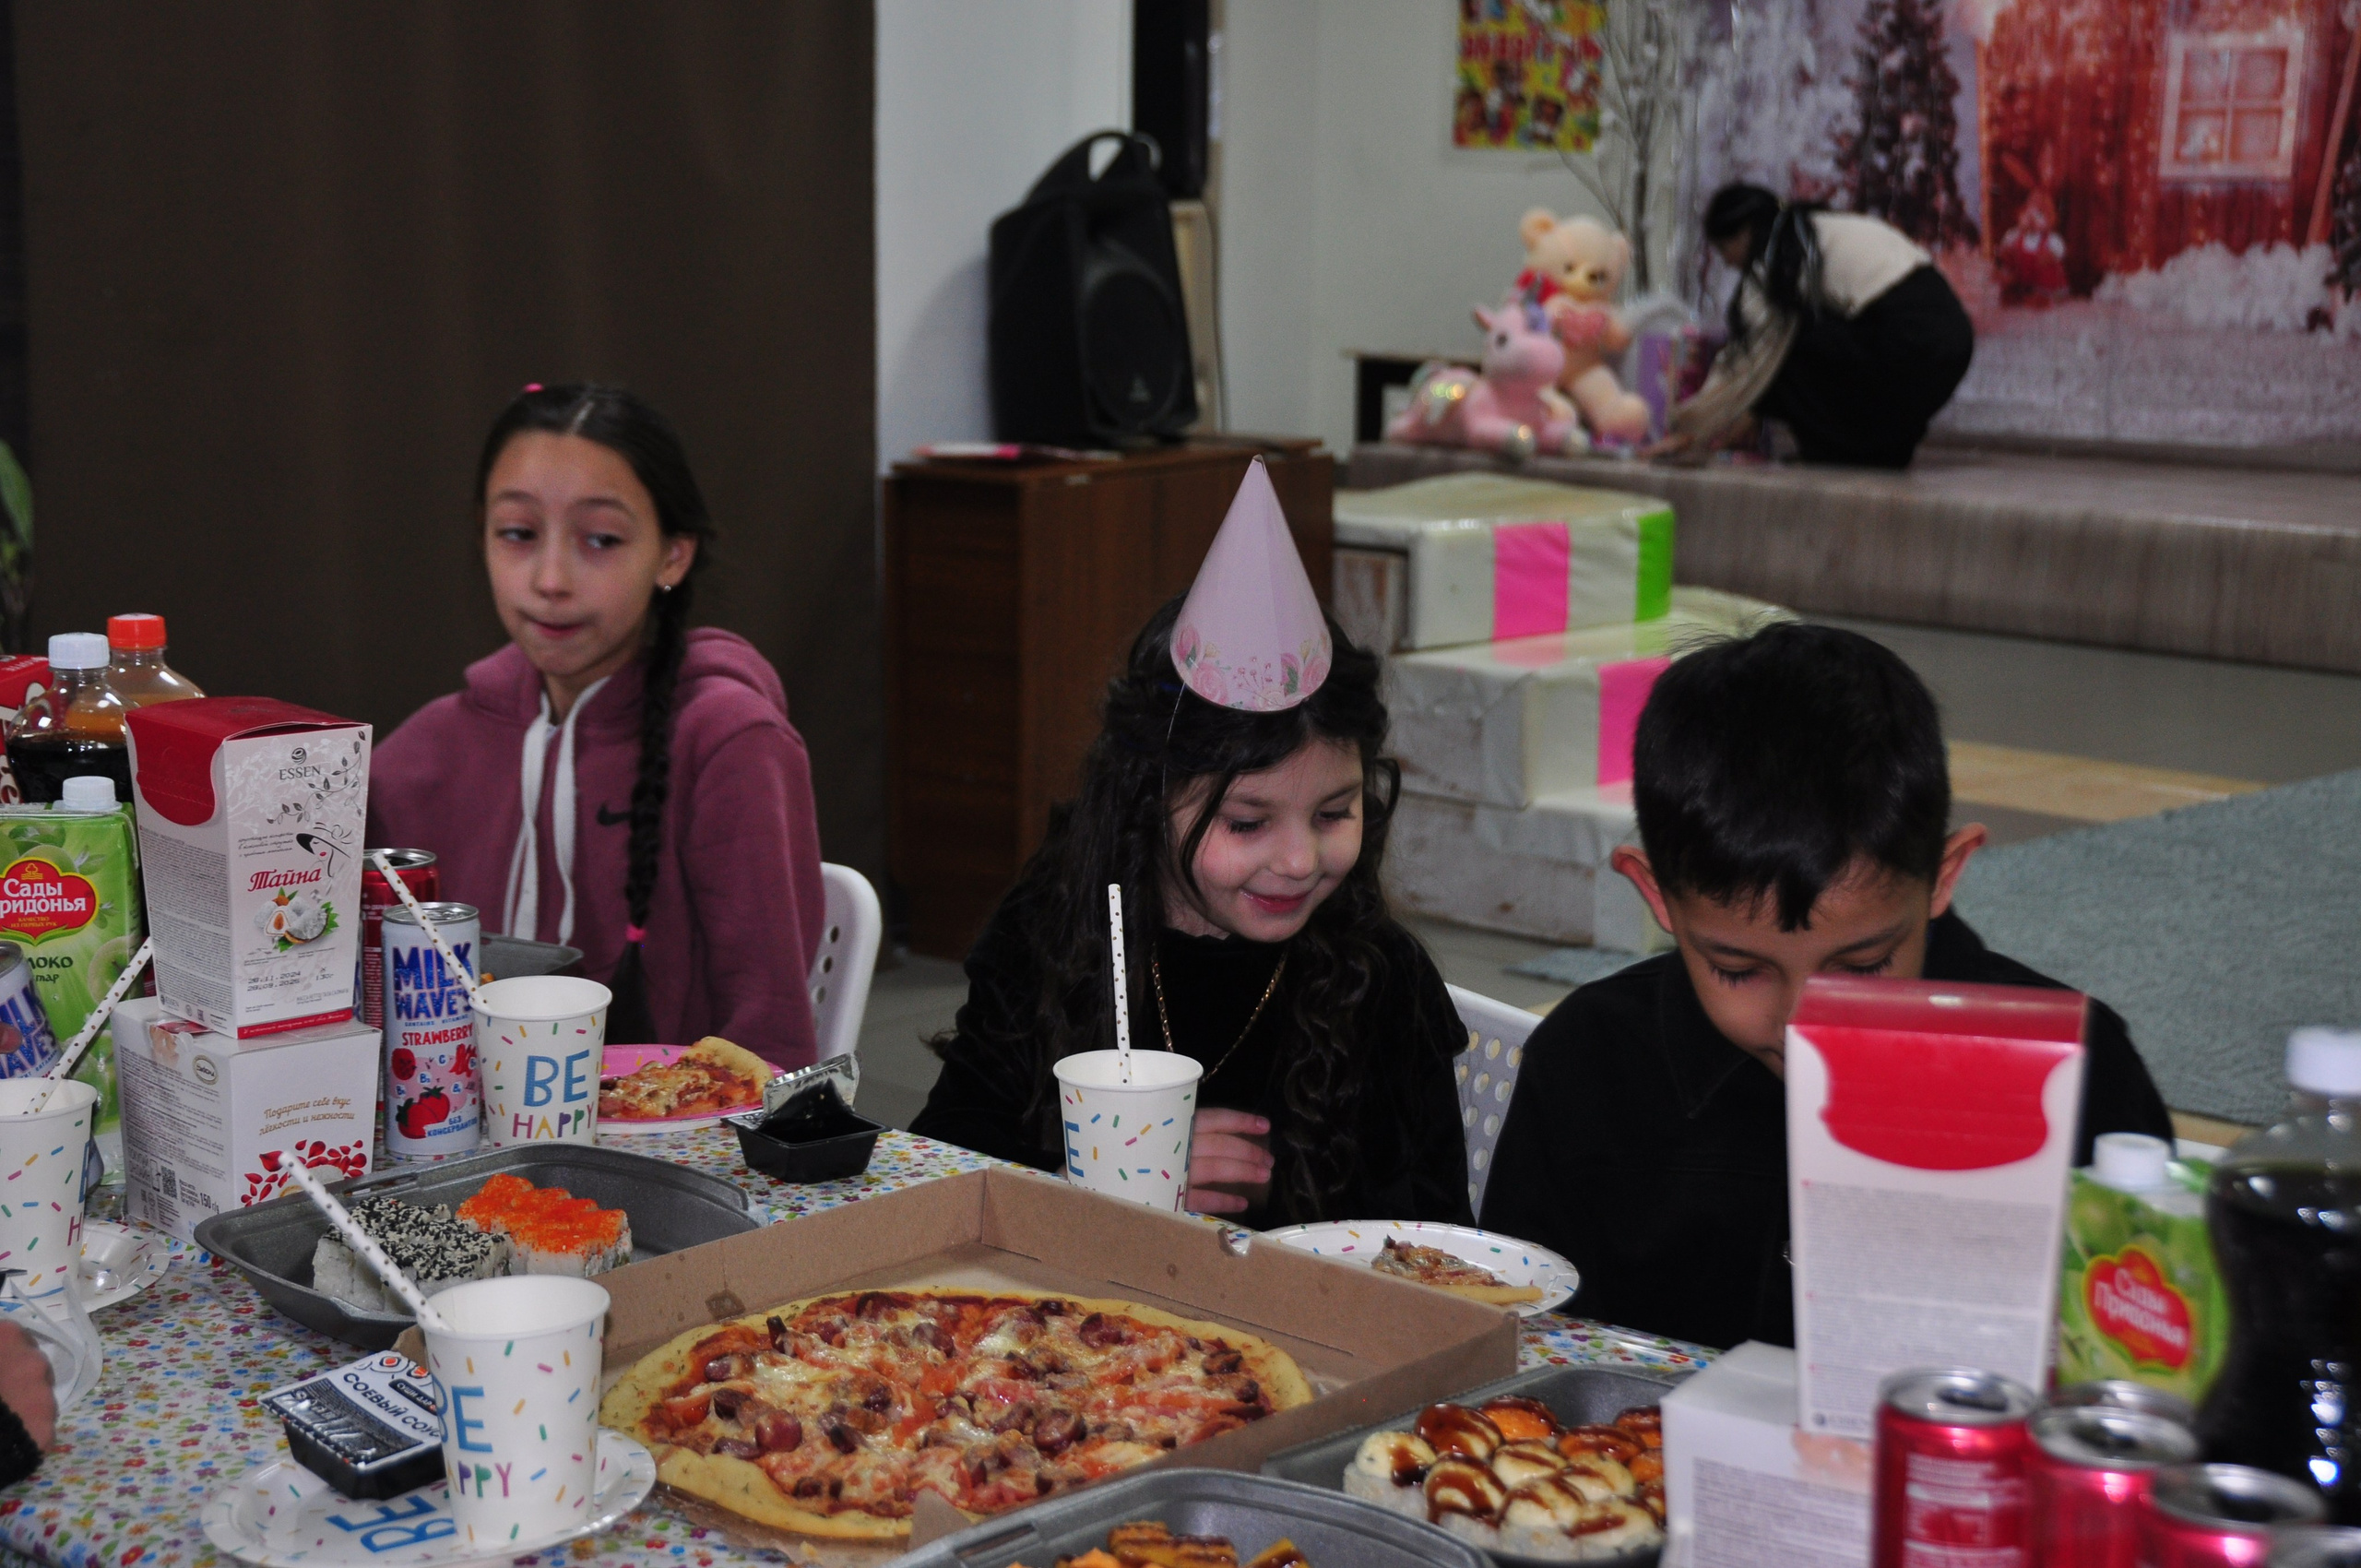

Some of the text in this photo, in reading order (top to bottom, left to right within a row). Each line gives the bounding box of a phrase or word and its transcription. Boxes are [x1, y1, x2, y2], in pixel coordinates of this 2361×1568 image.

[279, 766, 323, 780] ESSEN
[3, 878, 63, 898] Сады
[247, 867, 323, 892] Тайна
[0, 897, 87, 919] ридонья
[392, 941, 474, 992] MILK
[402, 1023, 473, 1046] STRAWBERRY
[524, 1049, 590, 1108] BE
[264, 1096, 351, 1120] Подарите себе вкус
[512, 1101, 595, 1139] HAPPY
[259, 1112, 355, 1136] лёгкости и нежности
[200, 1193, 211, 1208] 150
[343, 1372, 409, 1417] СОЕВЫЙ
[401, 1415, 440, 1437] СОУС
